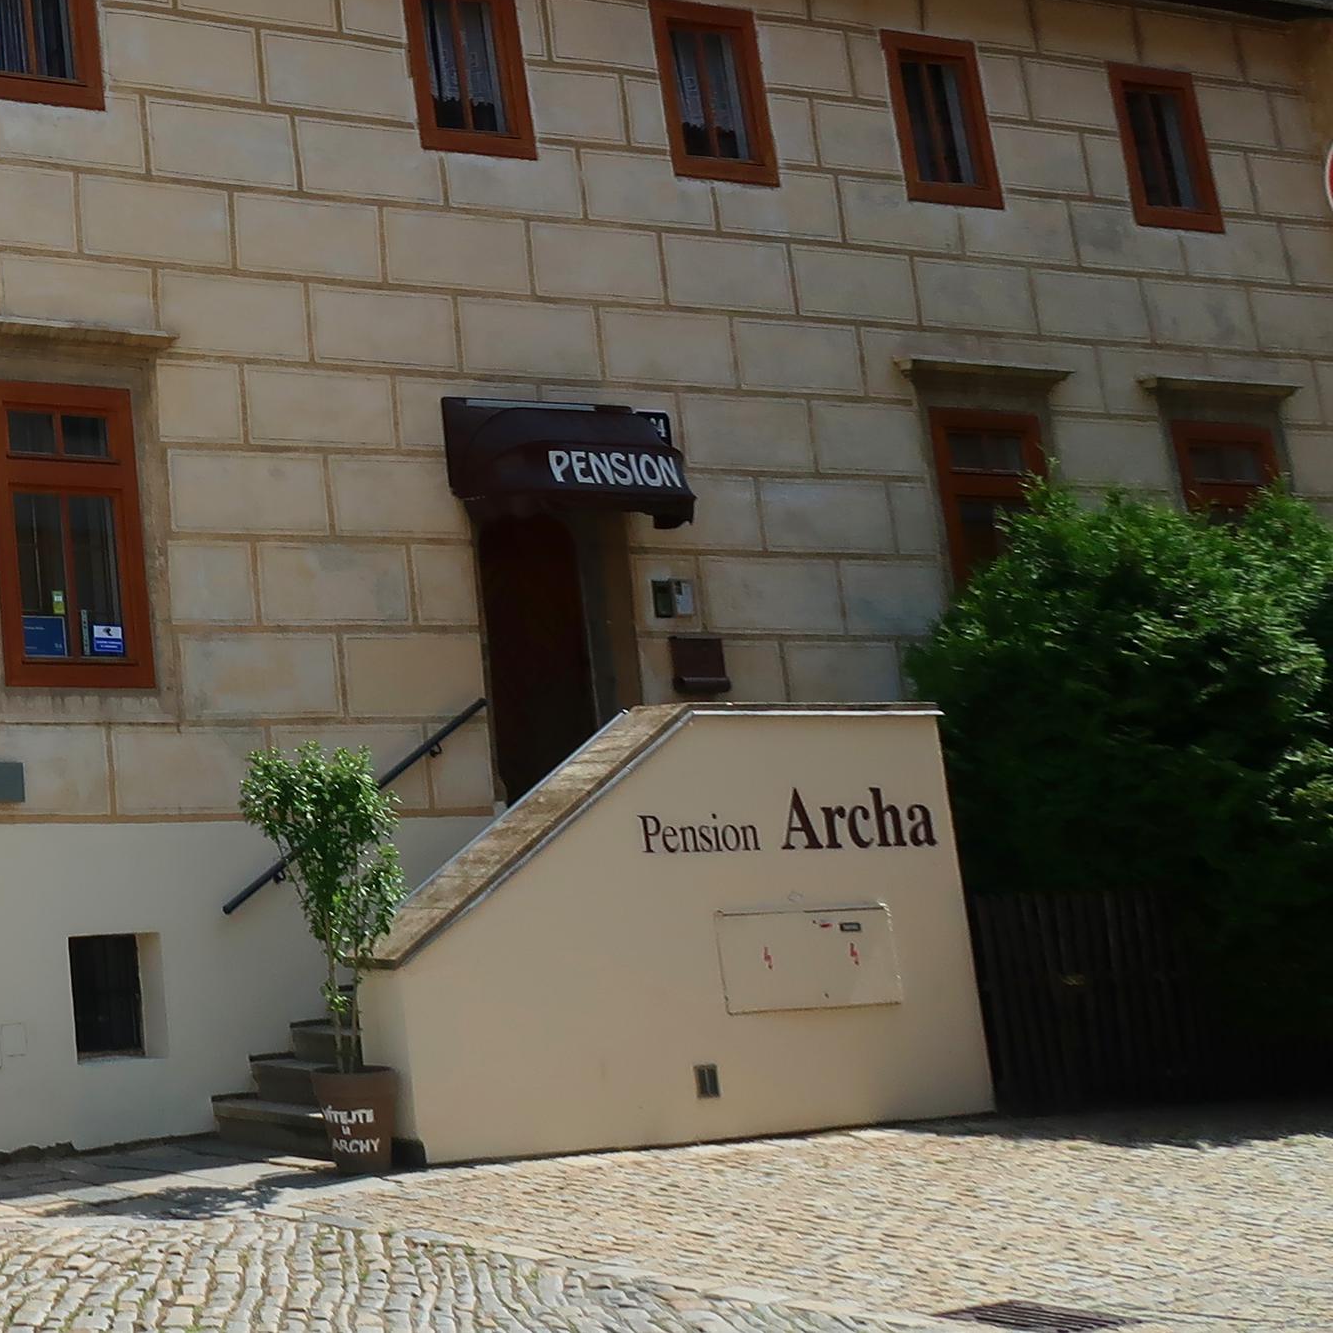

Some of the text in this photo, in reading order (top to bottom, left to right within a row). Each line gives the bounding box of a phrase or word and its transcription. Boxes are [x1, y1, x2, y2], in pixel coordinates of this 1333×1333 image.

[547, 449, 682, 488] PENSION
[637, 786, 938, 854] Pension Archa
[333, 1137, 380, 1154] ARCHY
